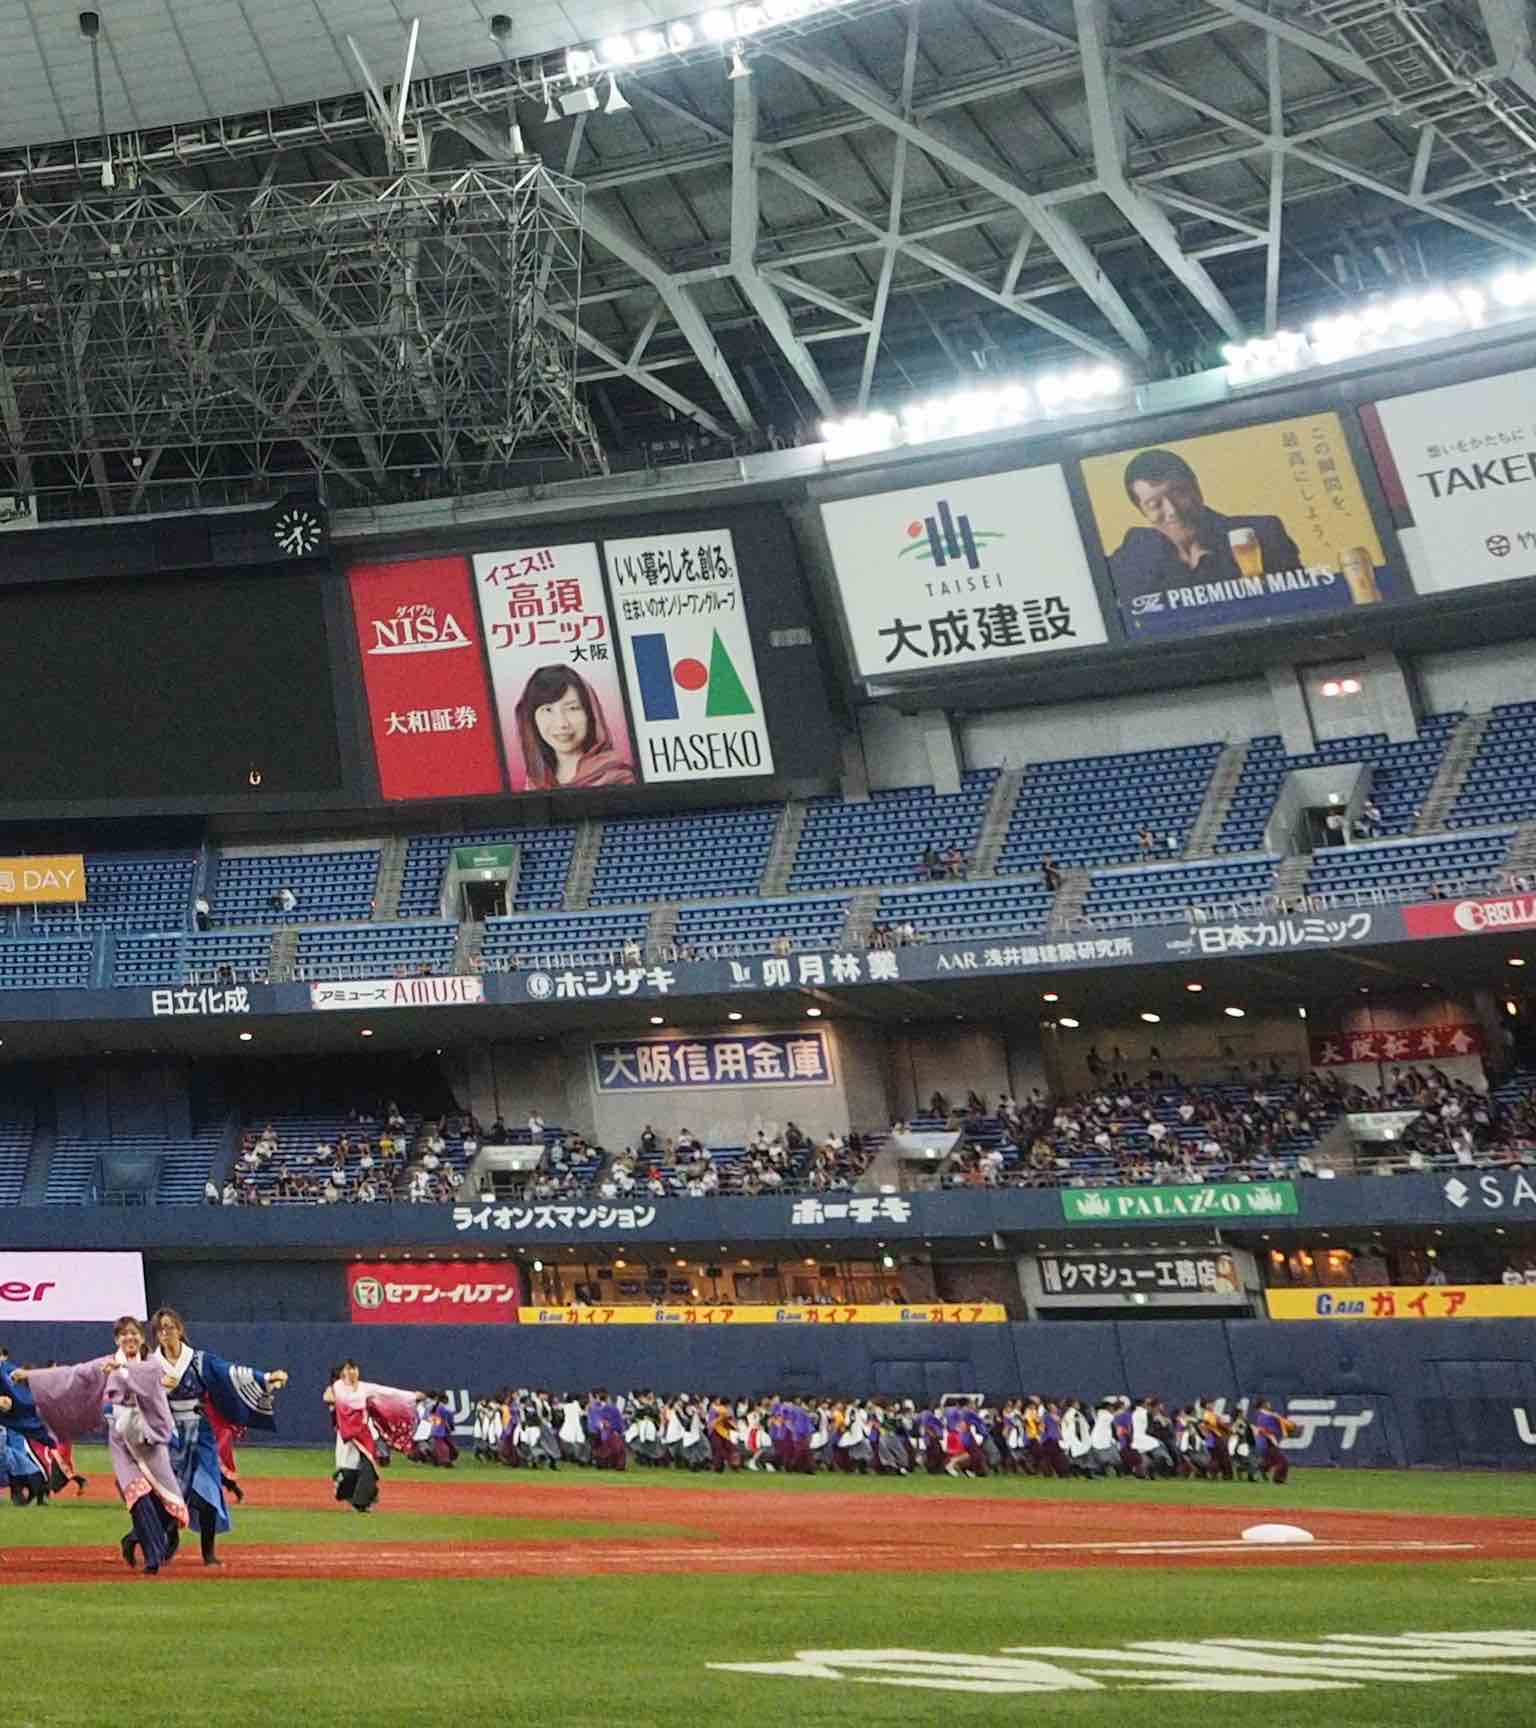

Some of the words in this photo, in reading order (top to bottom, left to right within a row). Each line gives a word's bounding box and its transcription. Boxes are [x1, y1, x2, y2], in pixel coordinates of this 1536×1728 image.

[484, 549, 555, 586] イエス!!
[507, 578, 584, 618] 高須
[925, 572, 1003, 597] TAISEI
[1166, 576, 1264, 609] PREMIUM
[371, 613, 468, 649] NISA
[491, 615, 607, 650] クリニック
[878, 595, 1077, 664] 大成建設
[570, 643, 609, 663] 大阪
[384, 705, 478, 736] 大和証券
[648, 729, 762, 774] HASEKO
[23, 869, 76, 892] DAY
[1198, 912, 1373, 954] 日本カルミック
[762, 950, 900, 988] 卯月林業
[936, 952, 978, 971] AAR
[319, 987, 390, 1003] アミューズ
[393, 978, 473, 1005] AMUSE
[555, 969, 676, 998] ホシザキ
[151, 985, 251, 1015] 日立化成
[601, 1036, 825, 1087] 大阪信用金庫
[791, 1196, 913, 1225] ホーチキ
[1118, 1187, 1242, 1217] PALAZZO
[452, 1204, 657, 1232] ライオンズマンション
[1061, 1257, 1217, 1290] クマシュー工務店
[566, 1309, 616, 1324] ガイア
[683, 1309, 735, 1324] ガイア
[805, 1307, 858, 1323] ガイア
[930, 1307, 984, 1323] ガイア
[1315, 1293, 1367, 1316] GAIA
[1370, 1290, 1468, 1318] ガイア
